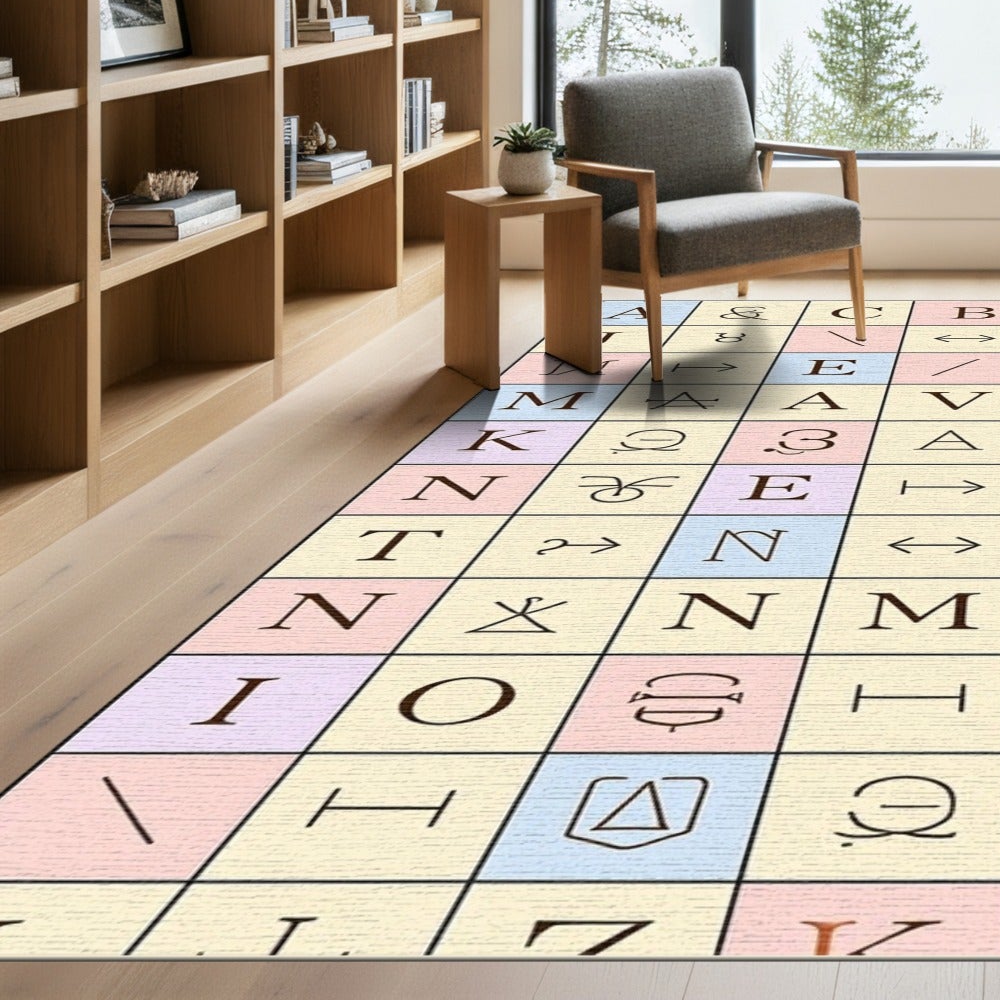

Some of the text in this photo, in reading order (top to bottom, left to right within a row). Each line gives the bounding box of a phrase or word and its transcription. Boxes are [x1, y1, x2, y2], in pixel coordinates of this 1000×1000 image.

[831, 306, 883, 319] C
[952, 307, 996, 319] B
[801, 360, 856, 375] E
[500, 391, 593, 410] M
[780, 392, 847, 410] A
[921, 392, 993, 410] V
[458, 430, 546, 451] K
[913, 430, 984, 450] A
[401, 476, 508, 501] N
[738, 475, 811, 500] E
[356, 530, 444, 561] T
[258, 593, 397, 630] N
[661, 593, 780, 630] N
[859, 593, 981, 630] M
[190, 677, 280, 725] I
[398, 677, 516, 726] O
